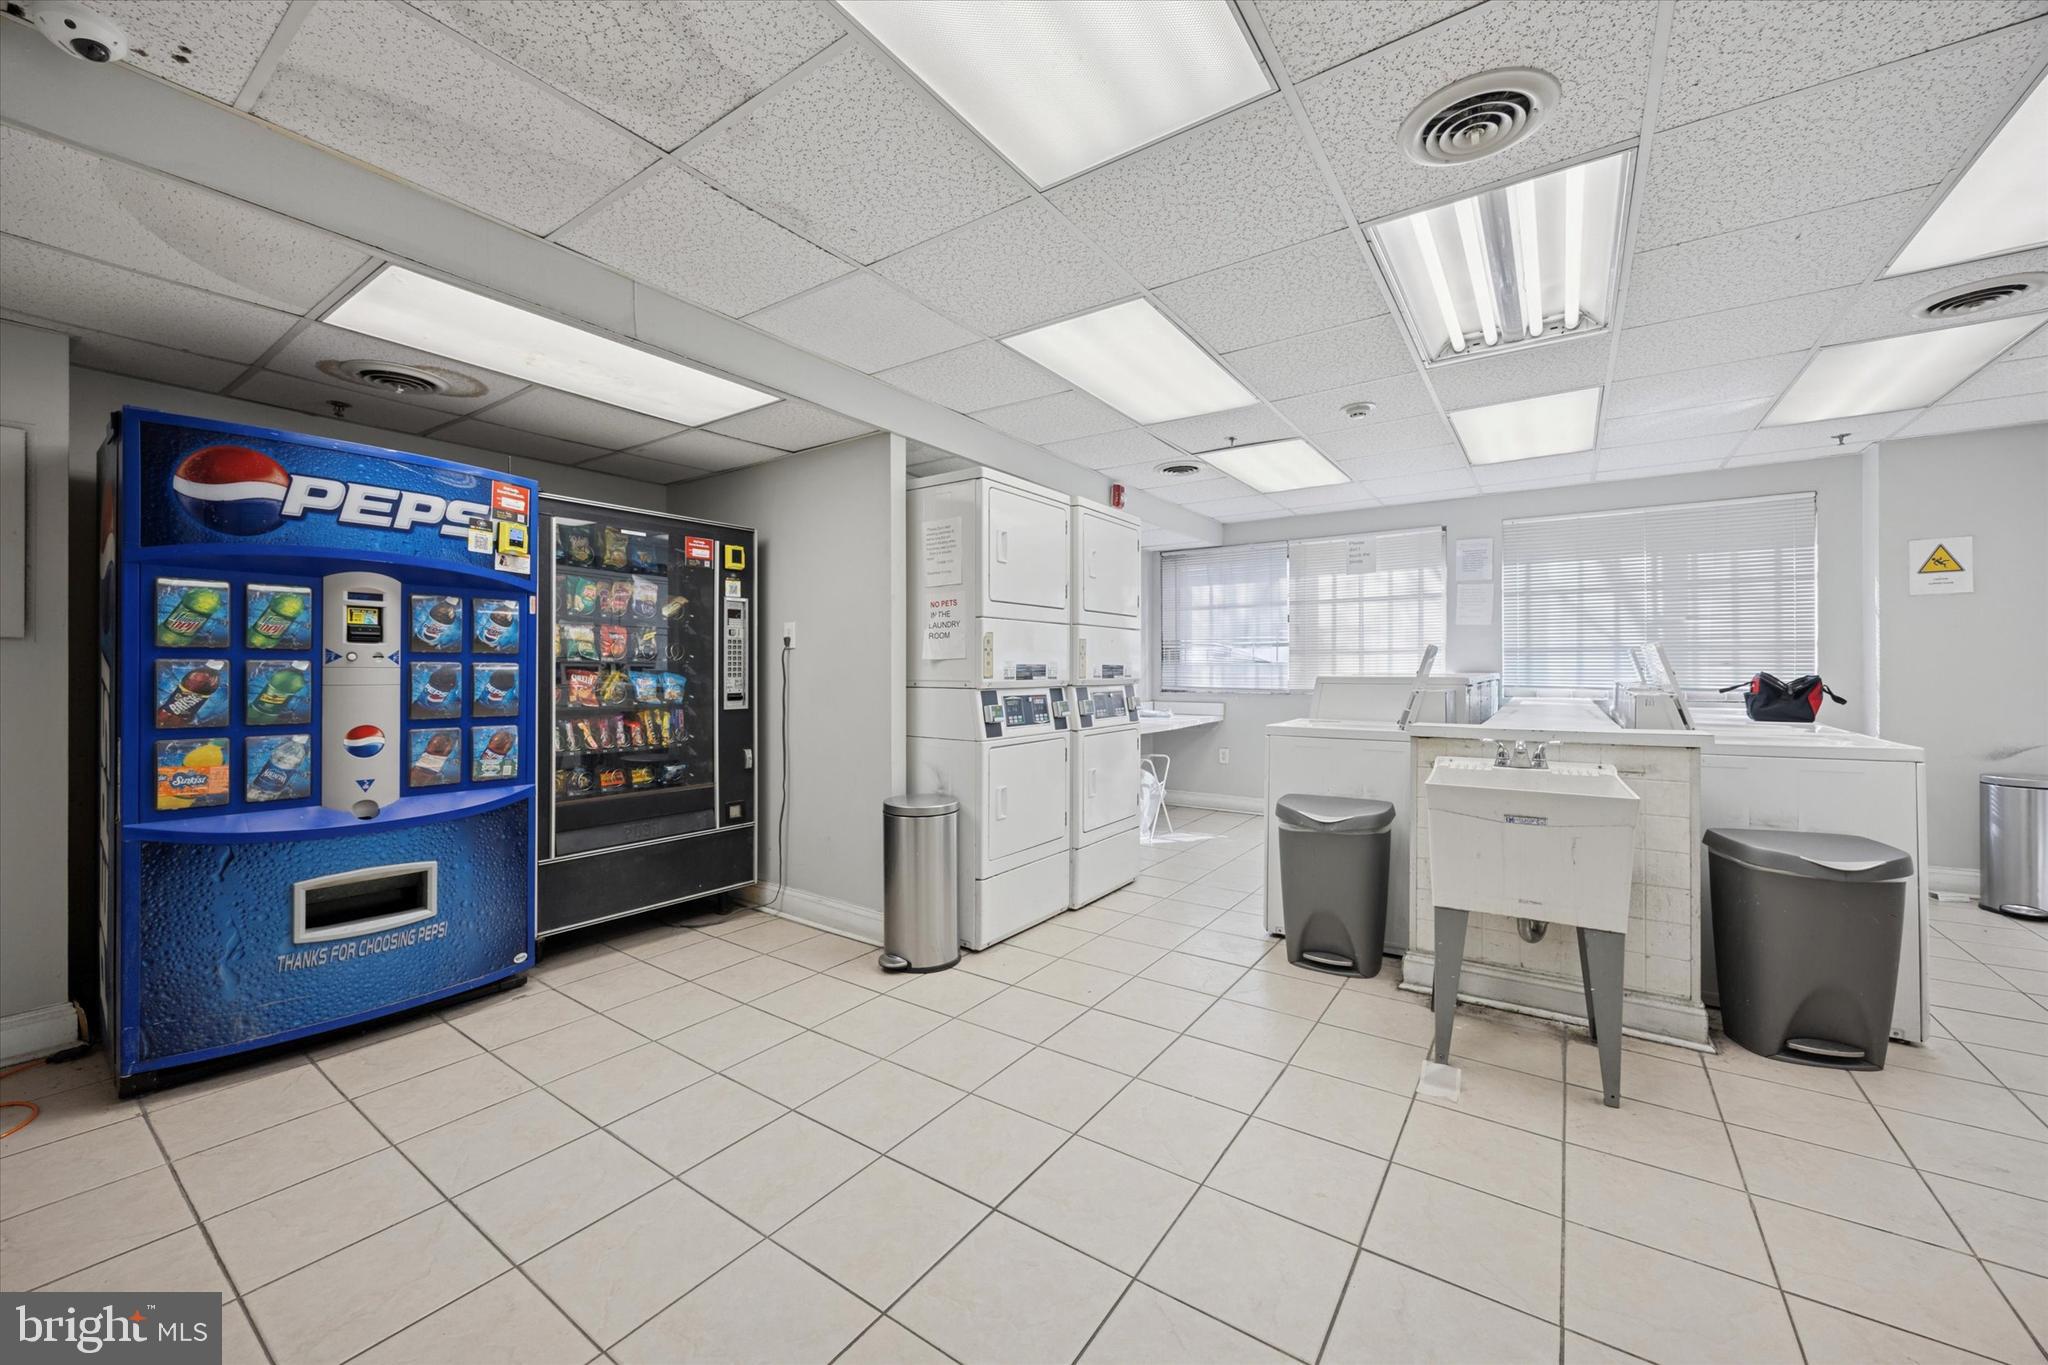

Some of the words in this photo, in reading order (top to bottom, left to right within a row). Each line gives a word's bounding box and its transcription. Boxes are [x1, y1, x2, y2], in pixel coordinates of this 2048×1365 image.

[938, 610, 951, 618] THE
[928, 620, 960, 629] LAUNDRY
[928, 631, 950, 639] ROOM
[172, 776, 207, 786] Sunkist
[277, 948, 327, 973] THANKS
[330, 942, 356, 962] FOR
[358, 930, 416, 955] CHOOSING
[418, 921, 448, 941] PEPSI
